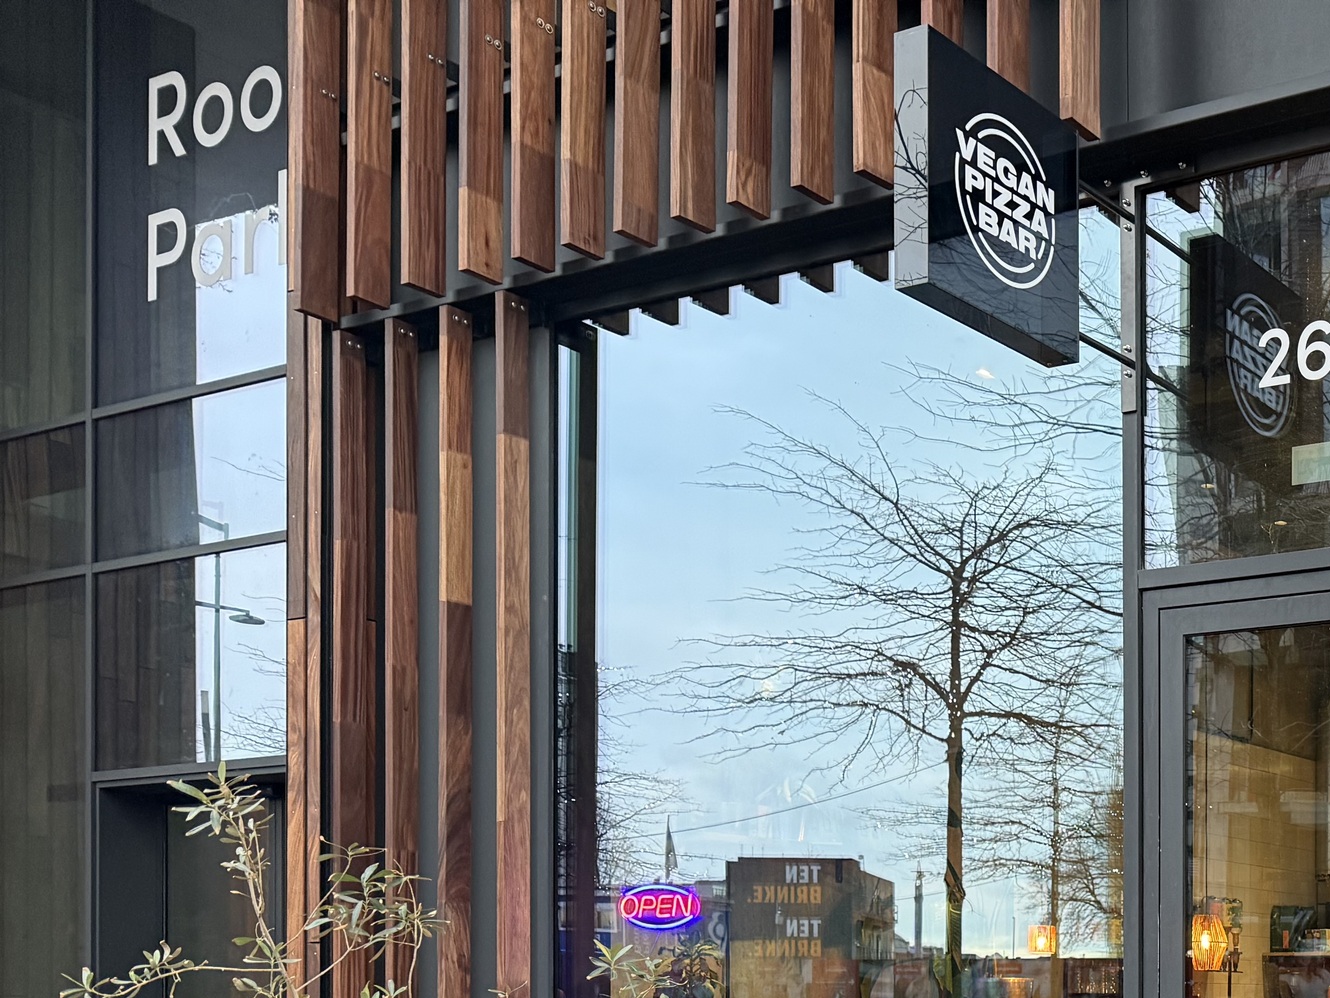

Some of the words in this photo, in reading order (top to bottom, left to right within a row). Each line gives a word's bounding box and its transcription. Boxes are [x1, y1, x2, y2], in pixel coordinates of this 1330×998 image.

[955, 128, 1055, 213] VEGAN
[148, 169, 287, 301] Par
[965, 171, 1049, 238] PIZZA
[978, 207, 1038, 260] BAR
[620, 893, 693, 918] OPEN
